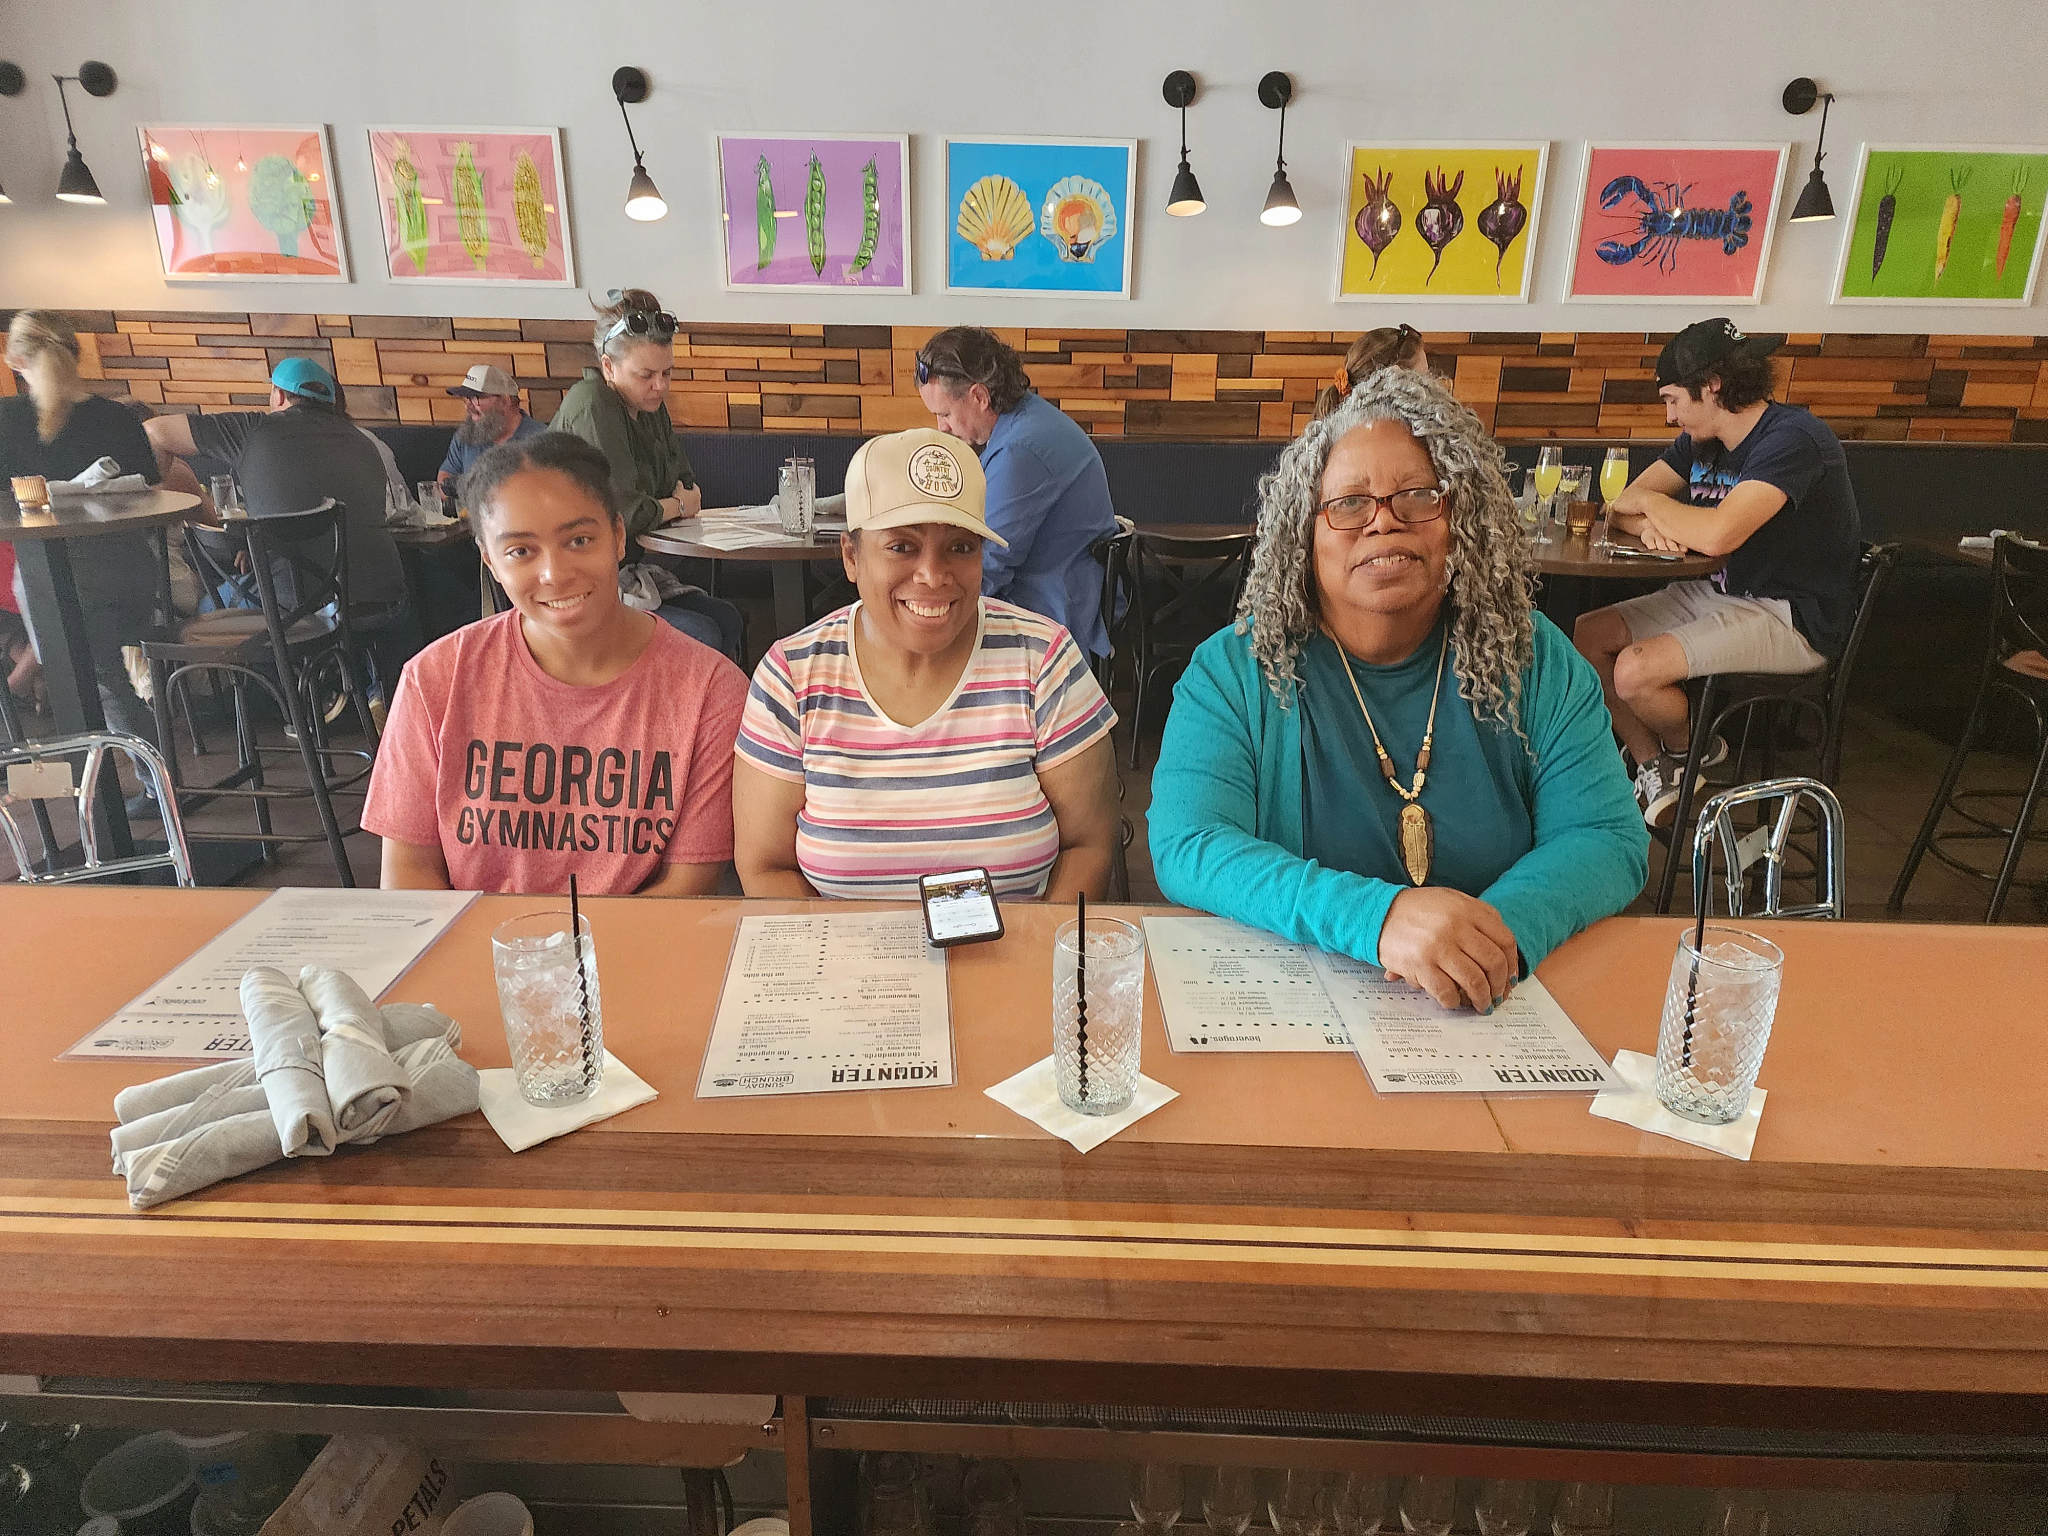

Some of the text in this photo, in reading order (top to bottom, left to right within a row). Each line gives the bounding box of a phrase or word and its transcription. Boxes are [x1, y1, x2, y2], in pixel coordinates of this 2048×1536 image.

[925, 479, 954, 492] HOOD
[464, 739, 674, 811] GEORGIA
[456, 806, 673, 854] GYMNASTICS
[1210, 1035, 1261, 1043] beverages.
[831, 1065, 938, 1083] KOUNTER
[1493, 1069, 1606, 1083] KOUNTER
[392, 1459, 448, 1536] PETALS
